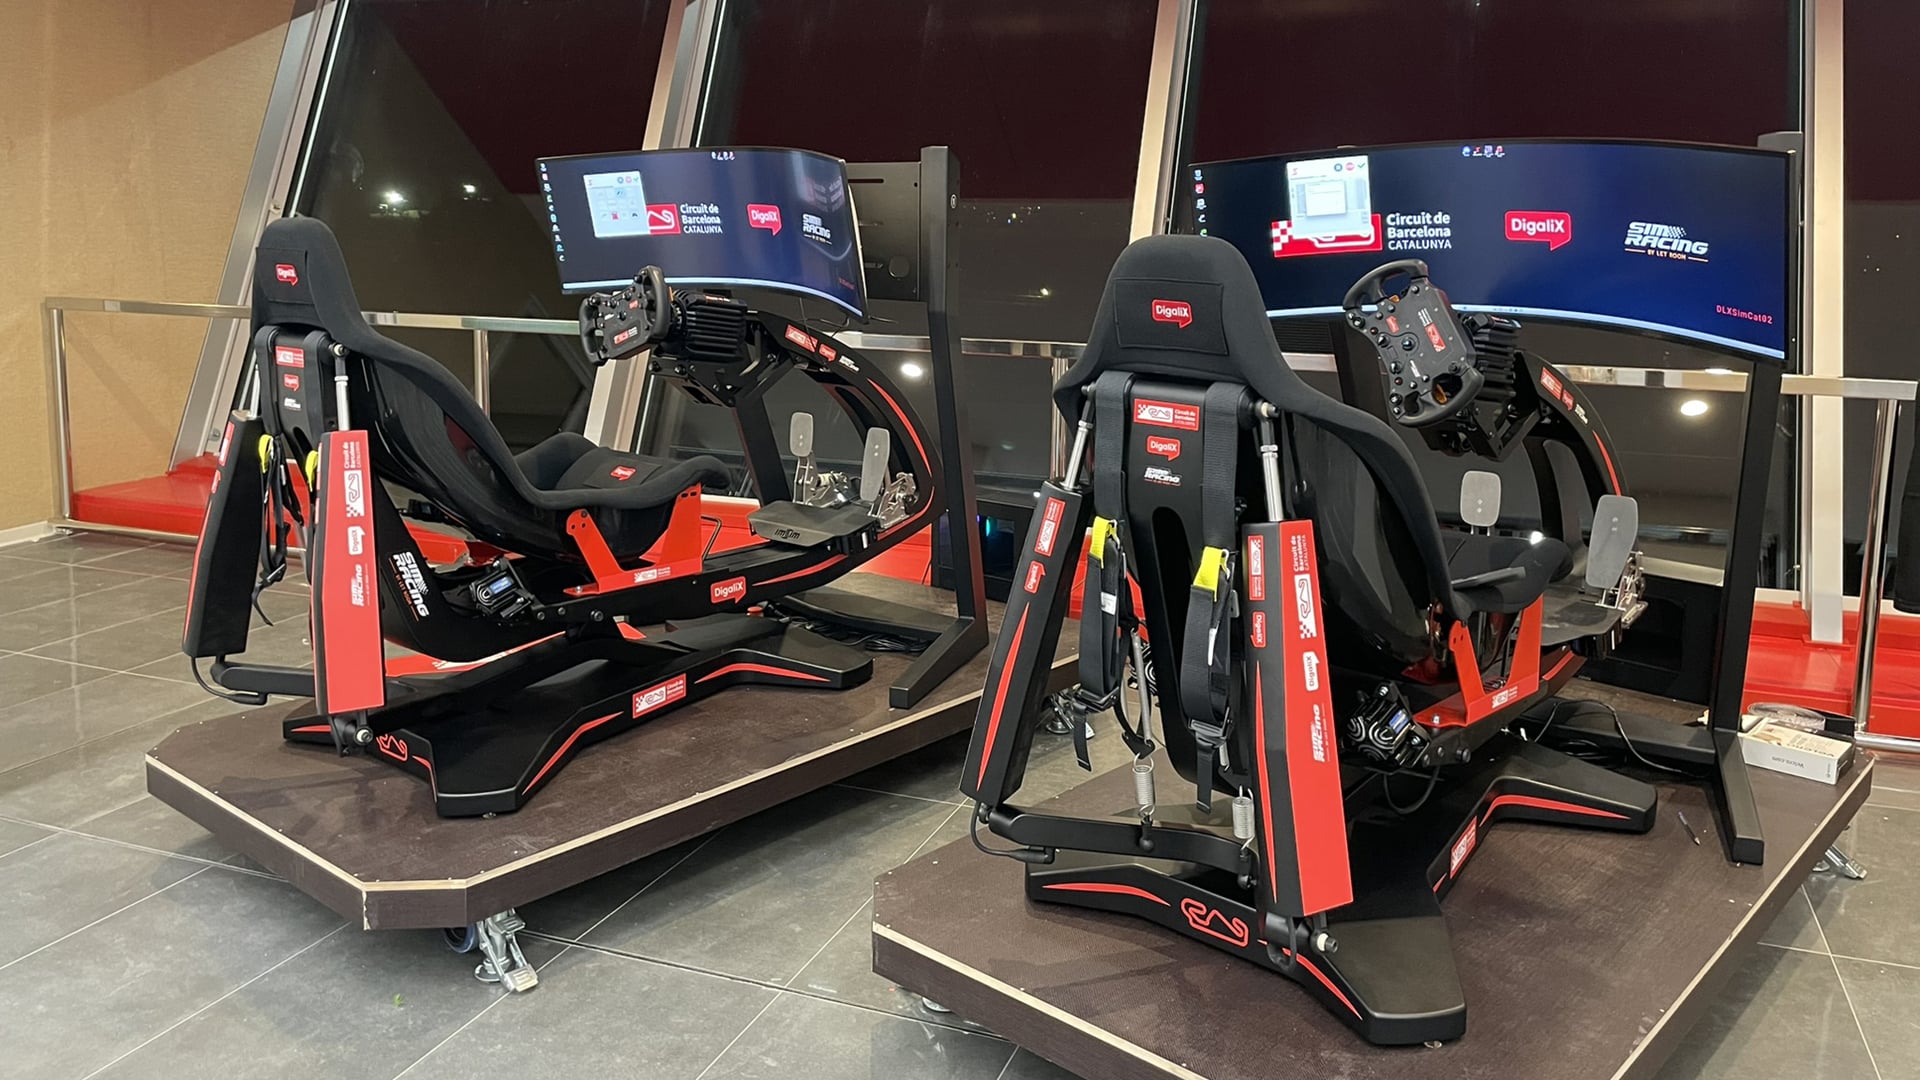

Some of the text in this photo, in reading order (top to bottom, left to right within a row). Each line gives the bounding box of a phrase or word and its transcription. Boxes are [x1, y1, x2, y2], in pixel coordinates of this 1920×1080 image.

[680, 203, 719, 214] Circuit de
[681, 214, 721, 225] Barcelona
[751, 209, 778, 225] DigaliX
[1386, 211, 1450, 226] Circuit de
[683, 225, 723, 234] CATALUNYA
[1387, 225, 1451, 239] Barcelona
[1511, 217, 1565, 236] DigaliX
[1627, 221, 1671, 238] SIM
[1388, 239, 1452, 250] CATALUNYA
[1624, 233, 1709, 255] RACING
[1155, 304, 1190, 318] DigaliX
[1150, 440, 1177, 452] DigaliX
[1291, 546, 1299, 572] Circuit
[1297, 535, 1305, 572] Barcelona
[392, 554, 430, 617] RACING
[714, 581, 744, 598] DigaliX
[1306, 656, 1316, 687] DigaliX
